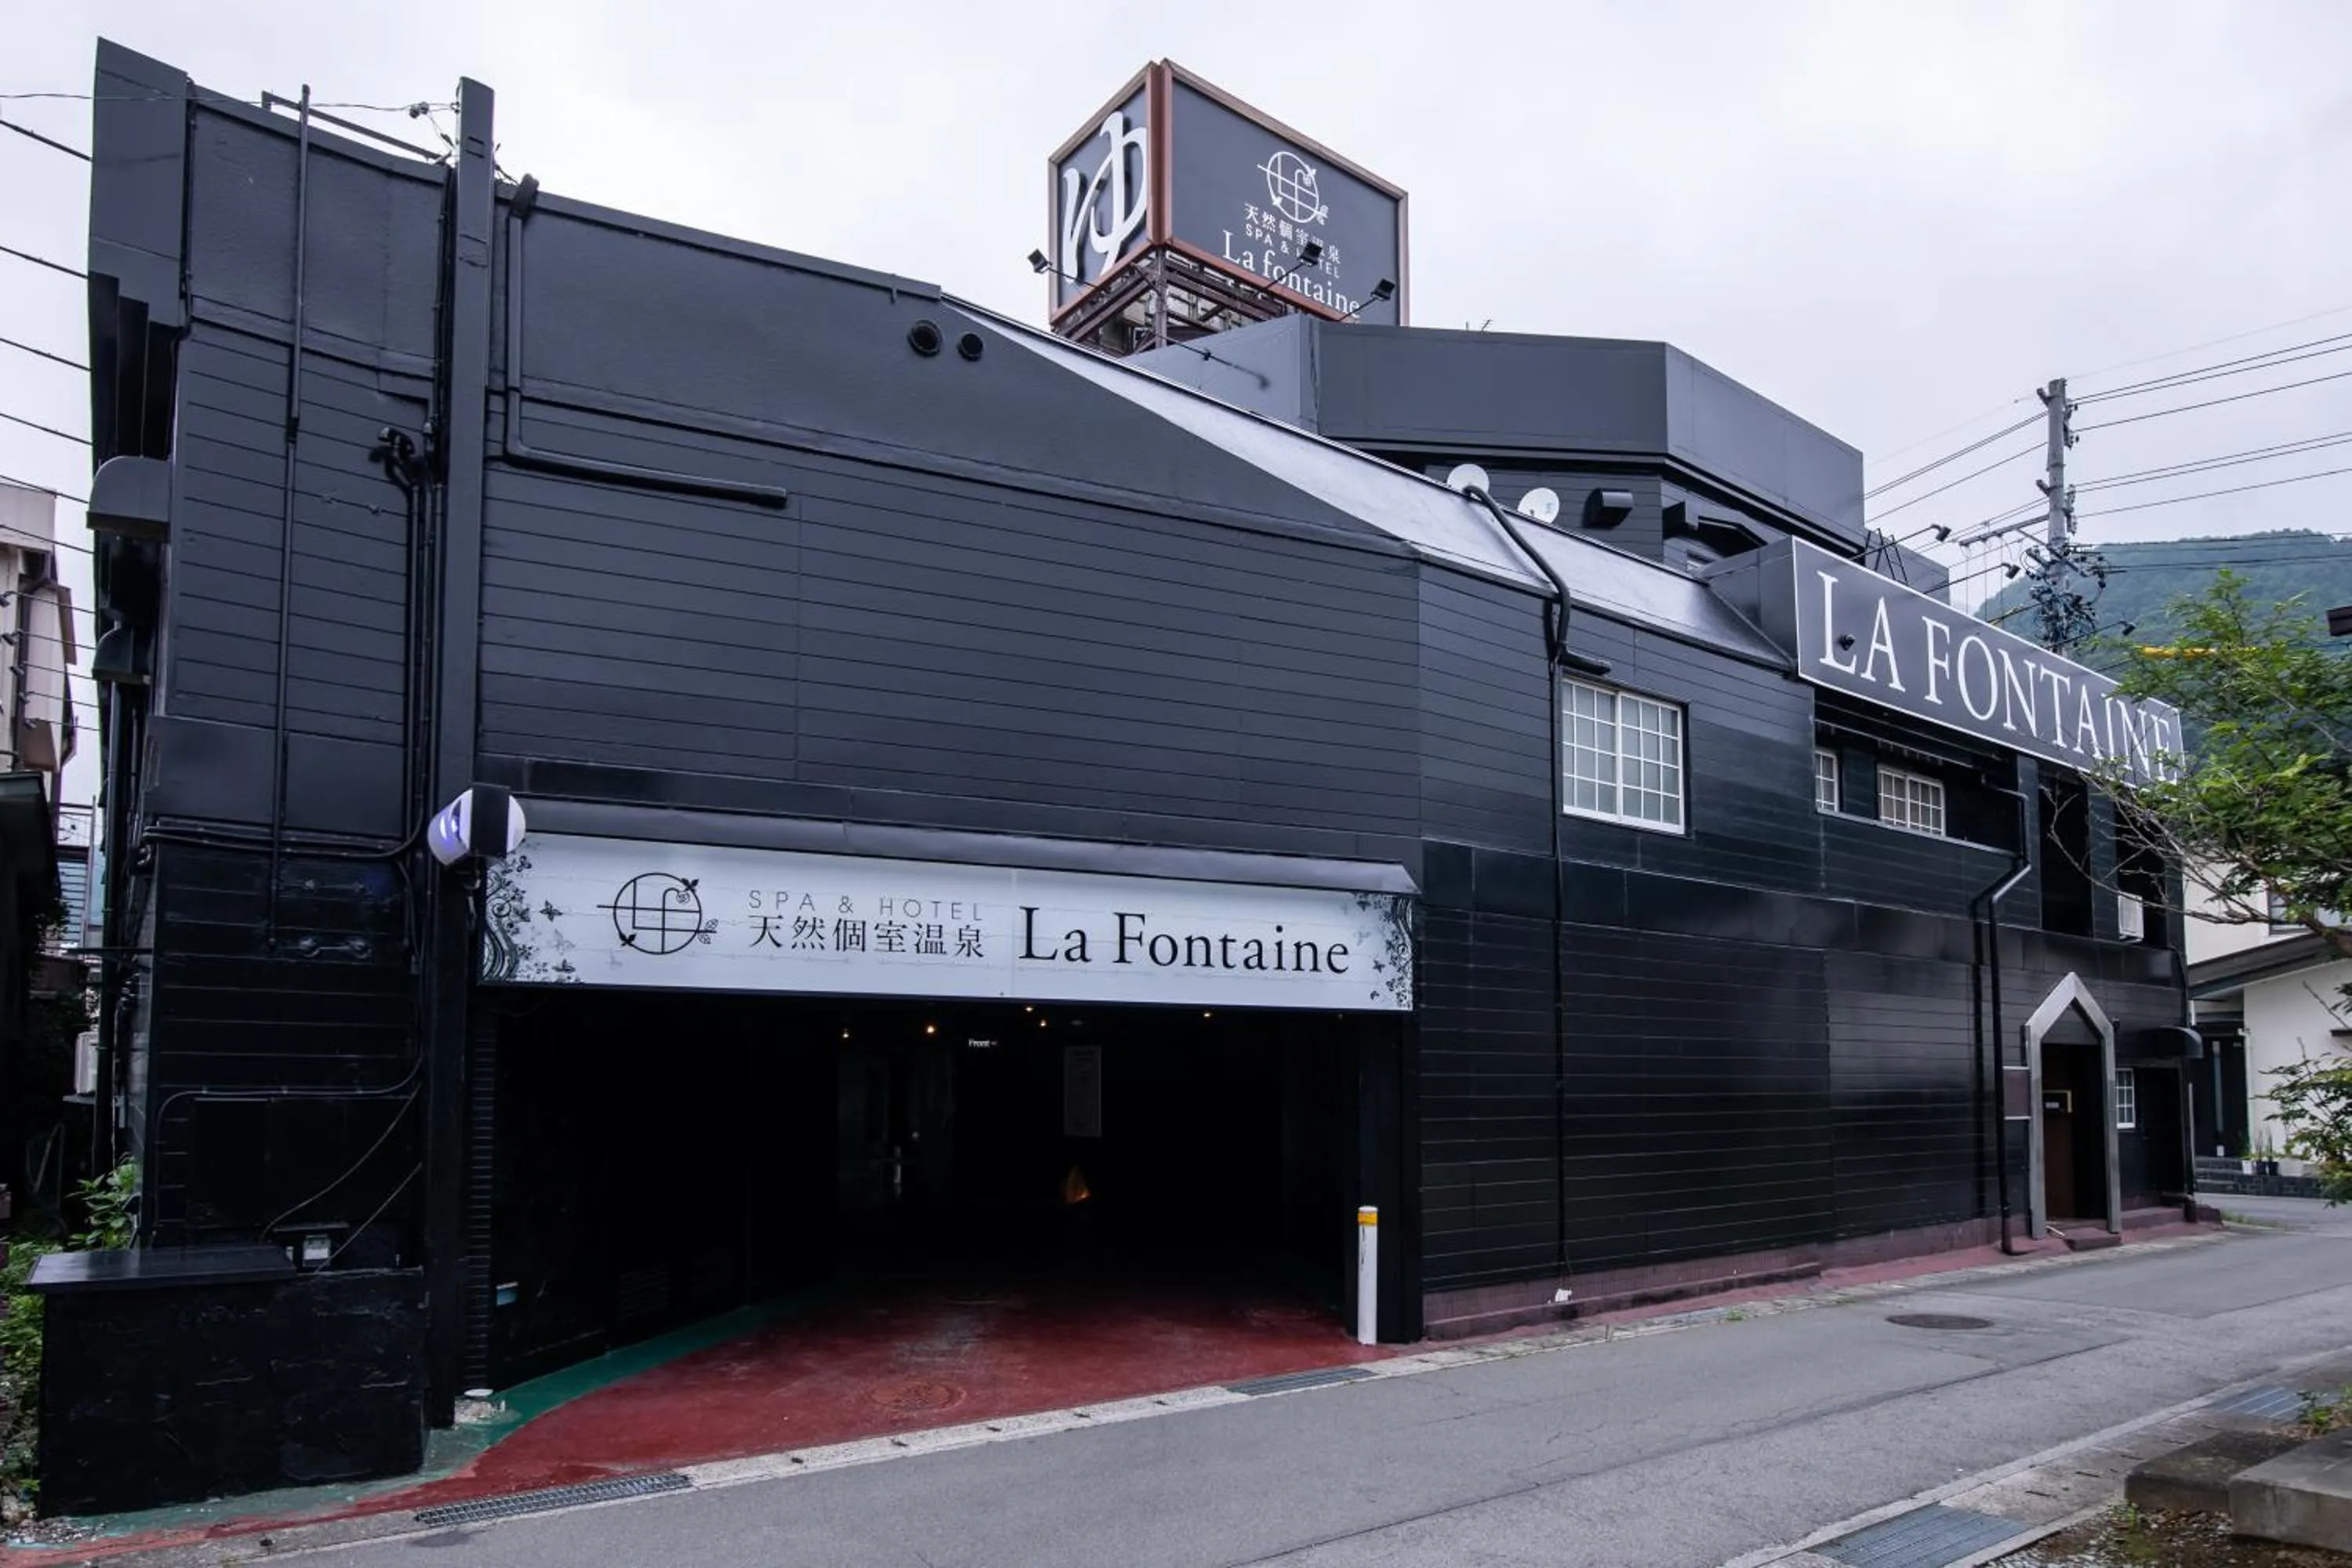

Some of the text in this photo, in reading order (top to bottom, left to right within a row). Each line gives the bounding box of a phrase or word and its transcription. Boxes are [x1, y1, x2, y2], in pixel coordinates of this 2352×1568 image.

[1063, 111, 1147, 282] ゆ
[1246, 223, 1272, 246] SPA
[1280, 241, 1290, 255] &
[1222, 230, 1361, 318] La fontaine
[1817, 571, 2178, 786] LA FONTAINE
[748, 890, 984, 921] SPA & HOTEL
[748, 914, 985, 958] 天然個室温泉
[1018, 906, 1350, 975] La Fontaine
